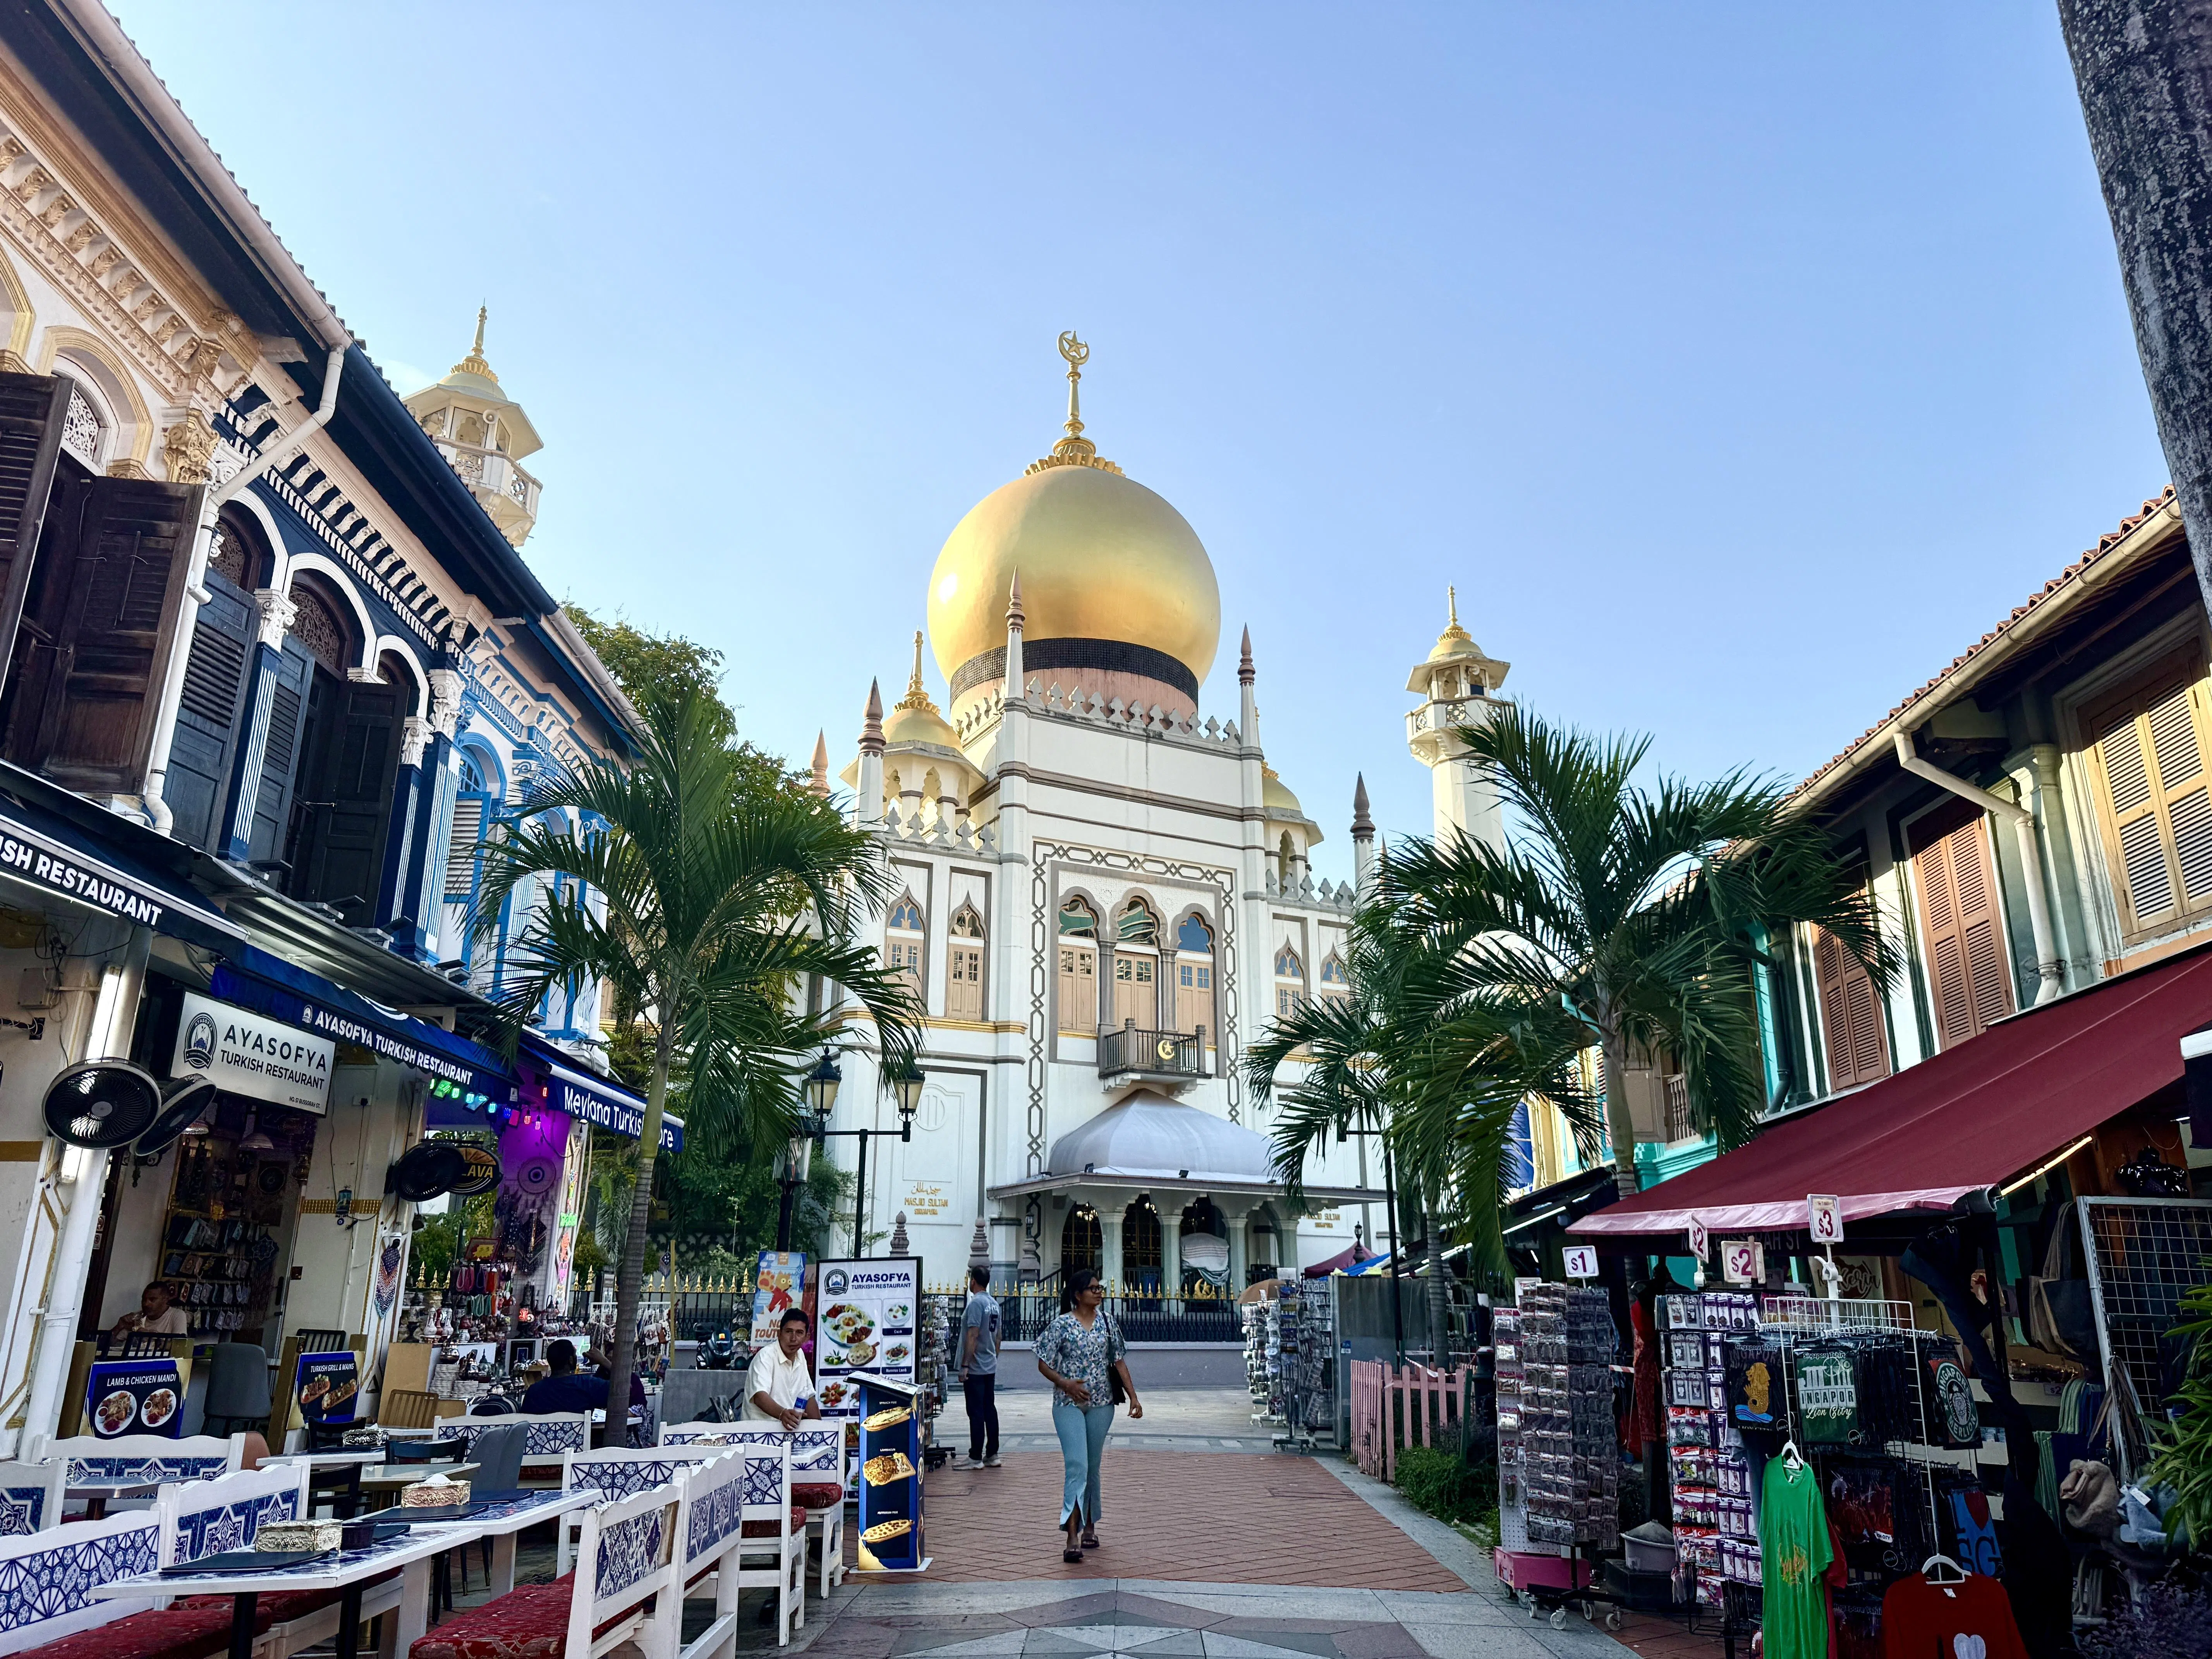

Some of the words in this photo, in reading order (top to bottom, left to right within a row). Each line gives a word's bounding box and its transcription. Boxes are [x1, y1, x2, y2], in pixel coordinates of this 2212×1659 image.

[34, 854, 162, 926] RESTAURANT
[223, 1024, 326, 1072] AYASOFYA
[315, 1010, 372, 1046] AYASOFYA
[376, 1034, 416, 1064] TURKISH
[417, 1052, 472, 1085] RESTAURANT
[220, 1049, 264, 1073] TURKISH
[265, 1063, 325, 1090] RESTAURANT
[565, 1086, 610, 1125] Mevlana
[659, 1127, 673, 1147] ore
[462, 1165, 493, 1178] AVA
[905, 1197, 925, 1206] MASJID
[928, 1199, 948, 1207] SULTAN
[1819, 1210, 1833, 1237] $3
[1693, 1227, 1704, 1254] $2
[1571, 1251, 1587, 1273] $1
[1731, 1249, 1752, 1276] $2
[852, 1273, 910, 1283] AYASOFYA
[755, 1329, 779, 1338] TOUT
[107, 1377, 125, 1386] LAMB
[125, 1377, 130, 1385] &
[131, 1375, 157, 1385] CHICKEN
[157, 1374, 177, 1382] MANDI
[1939, 1367, 1971, 1399] SINGAPORE
[1802, 1390, 1854, 1404] INGAPOR
[1806, 1405, 1826, 1419] Lion
[1829, 1405, 1853, 1419] City
[1948, 1413, 1977, 1438] MERLION
